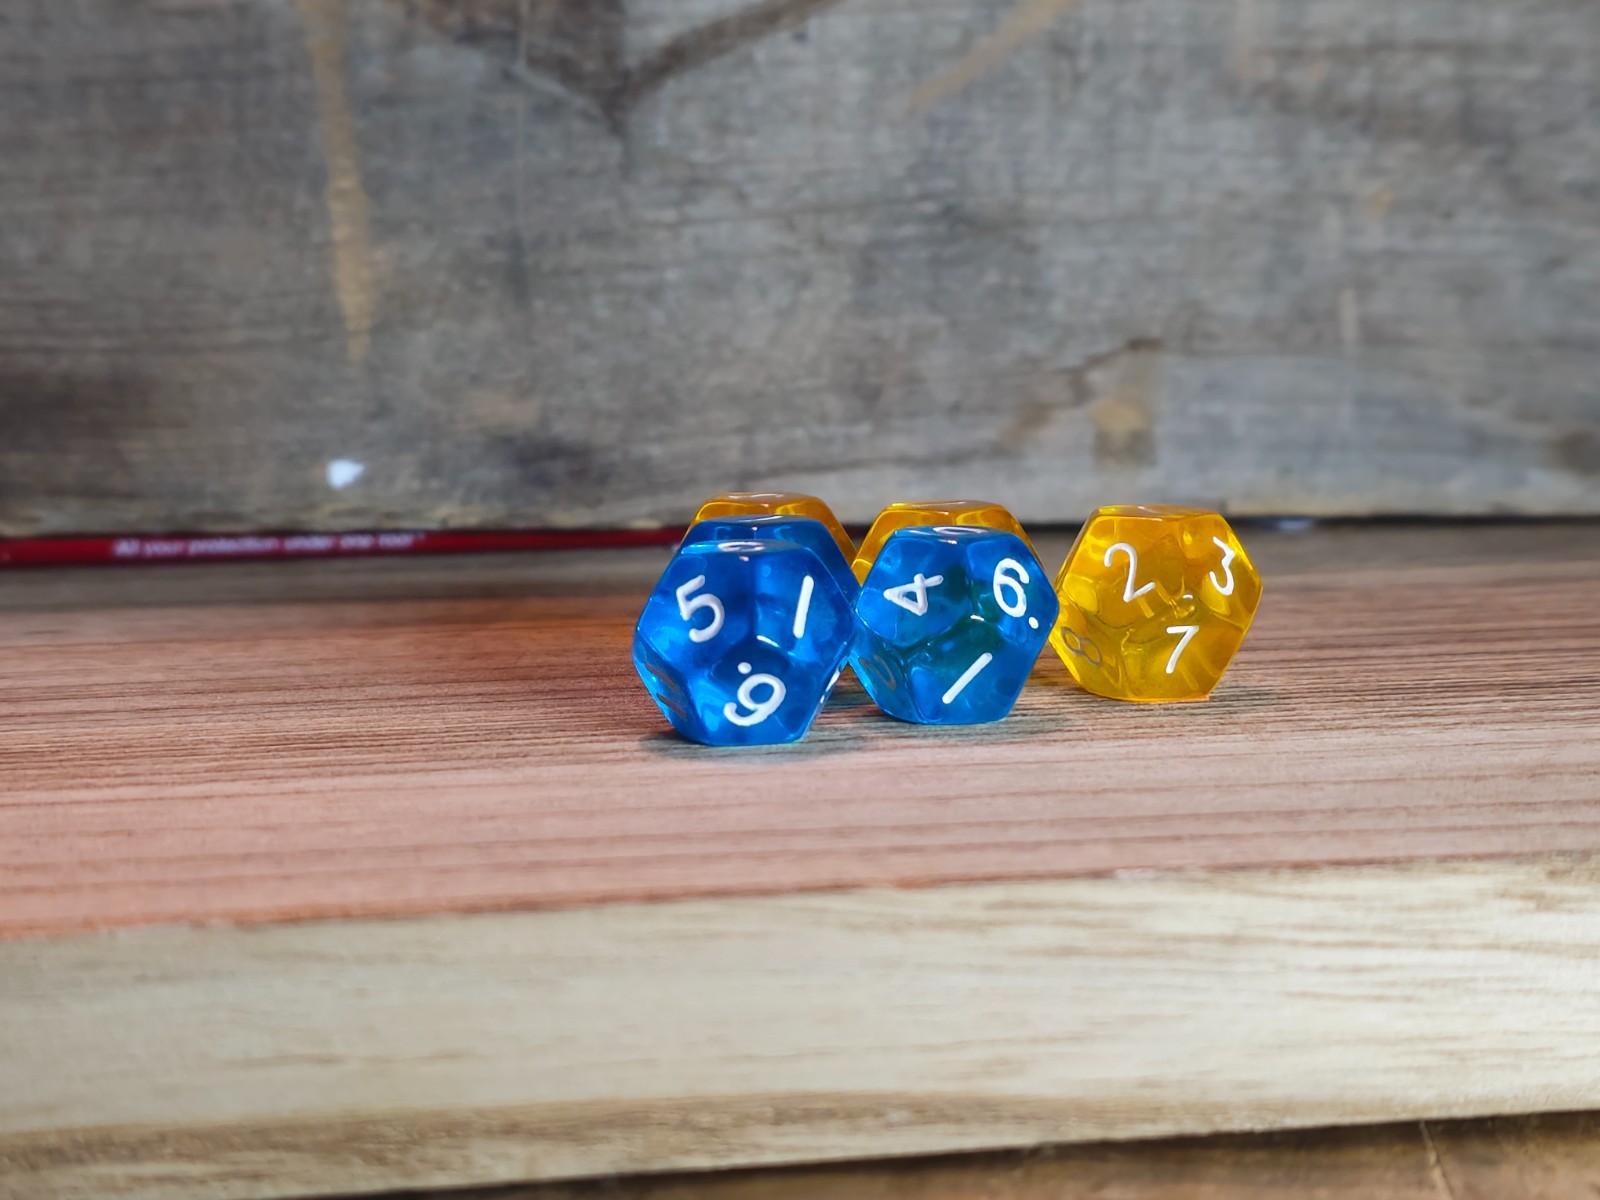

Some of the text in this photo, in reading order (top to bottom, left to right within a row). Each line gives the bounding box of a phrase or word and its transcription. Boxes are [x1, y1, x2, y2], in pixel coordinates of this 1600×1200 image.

[1104, 543, 1155, 602] 2
[1209, 536, 1236, 596] 3
[676, 575, 725, 643] 5
[793, 575, 814, 639] 1
[883, 573, 943, 616] 4
[1060, 626, 1102, 667] 8
[1166, 625, 1199, 674] 7
[942, 652, 993, 705] 1
